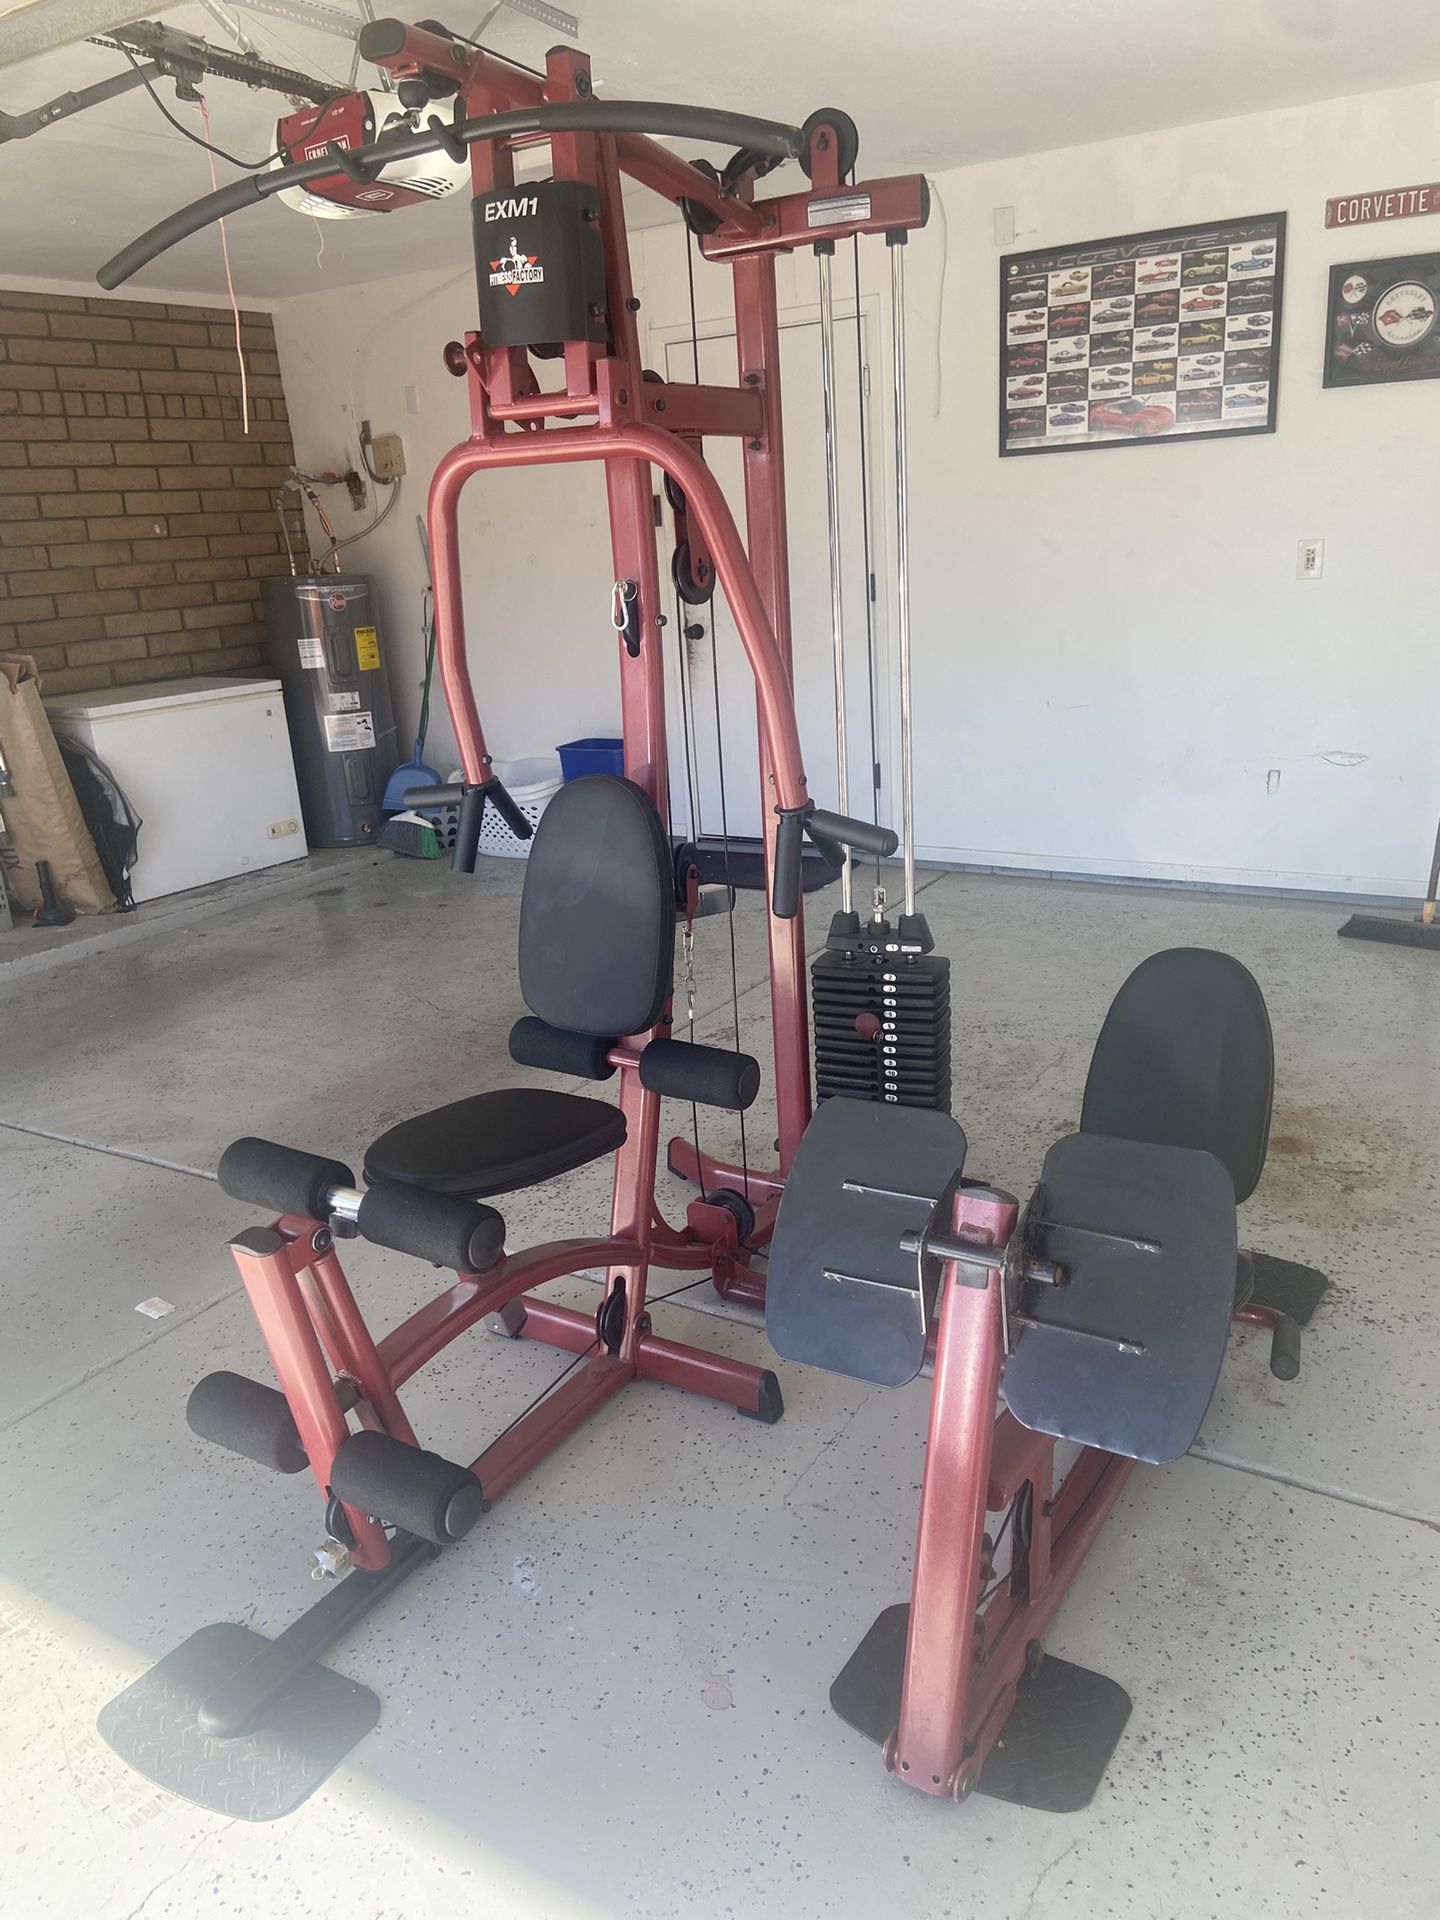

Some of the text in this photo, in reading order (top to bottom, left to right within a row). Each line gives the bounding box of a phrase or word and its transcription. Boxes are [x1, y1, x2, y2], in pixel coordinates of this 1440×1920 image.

[484, 197, 538, 223] EXM1
[1337, 189, 1430, 223] CORVETTE
[1055, 232, 1219, 269] CORVETTE
